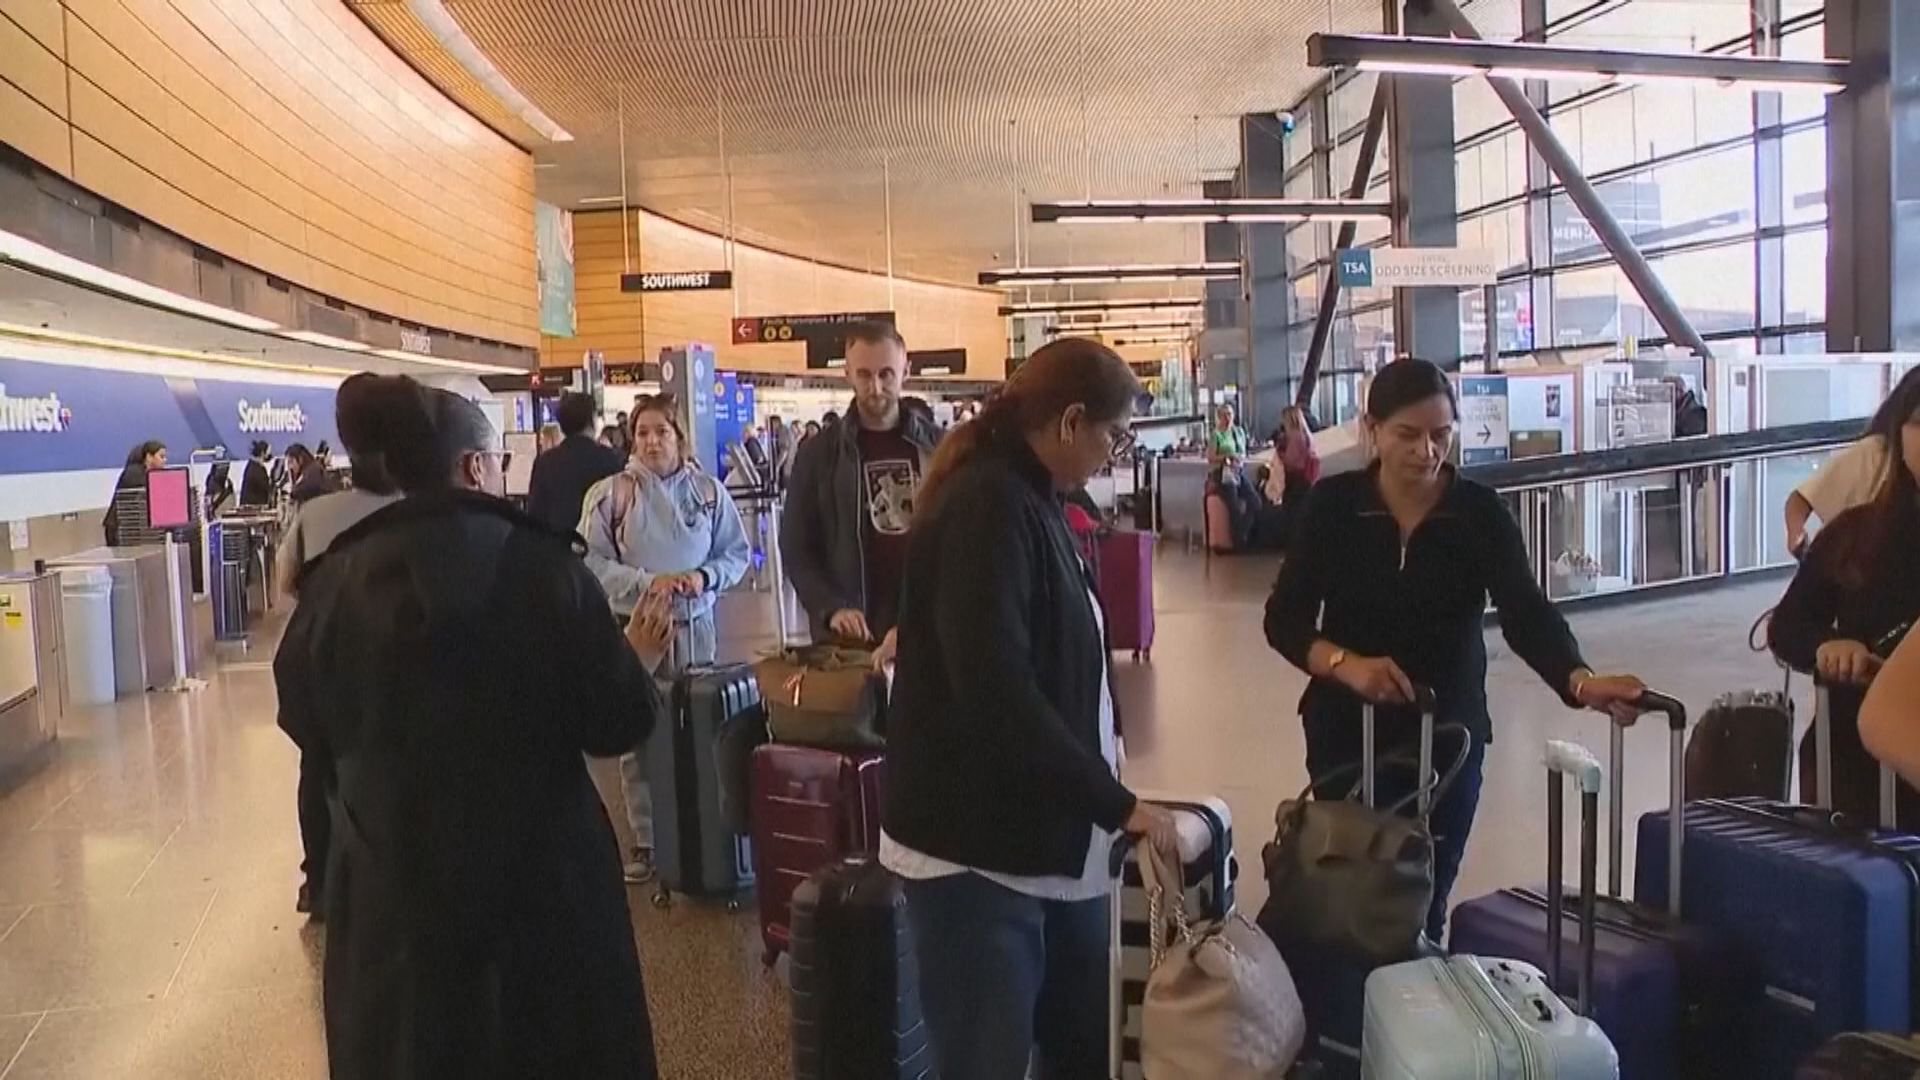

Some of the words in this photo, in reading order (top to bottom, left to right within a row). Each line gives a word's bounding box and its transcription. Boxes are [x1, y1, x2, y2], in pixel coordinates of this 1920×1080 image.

[1343, 261, 1367, 274] TSA
[1375, 265, 1401, 276] ODD
[1403, 265, 1427, 276] SIZE
[1429, 264, 1492, 276] SCREENING
[641, 273, 711, 289] SOUTHWEST
[237, 397, 303, 432] Southwest
